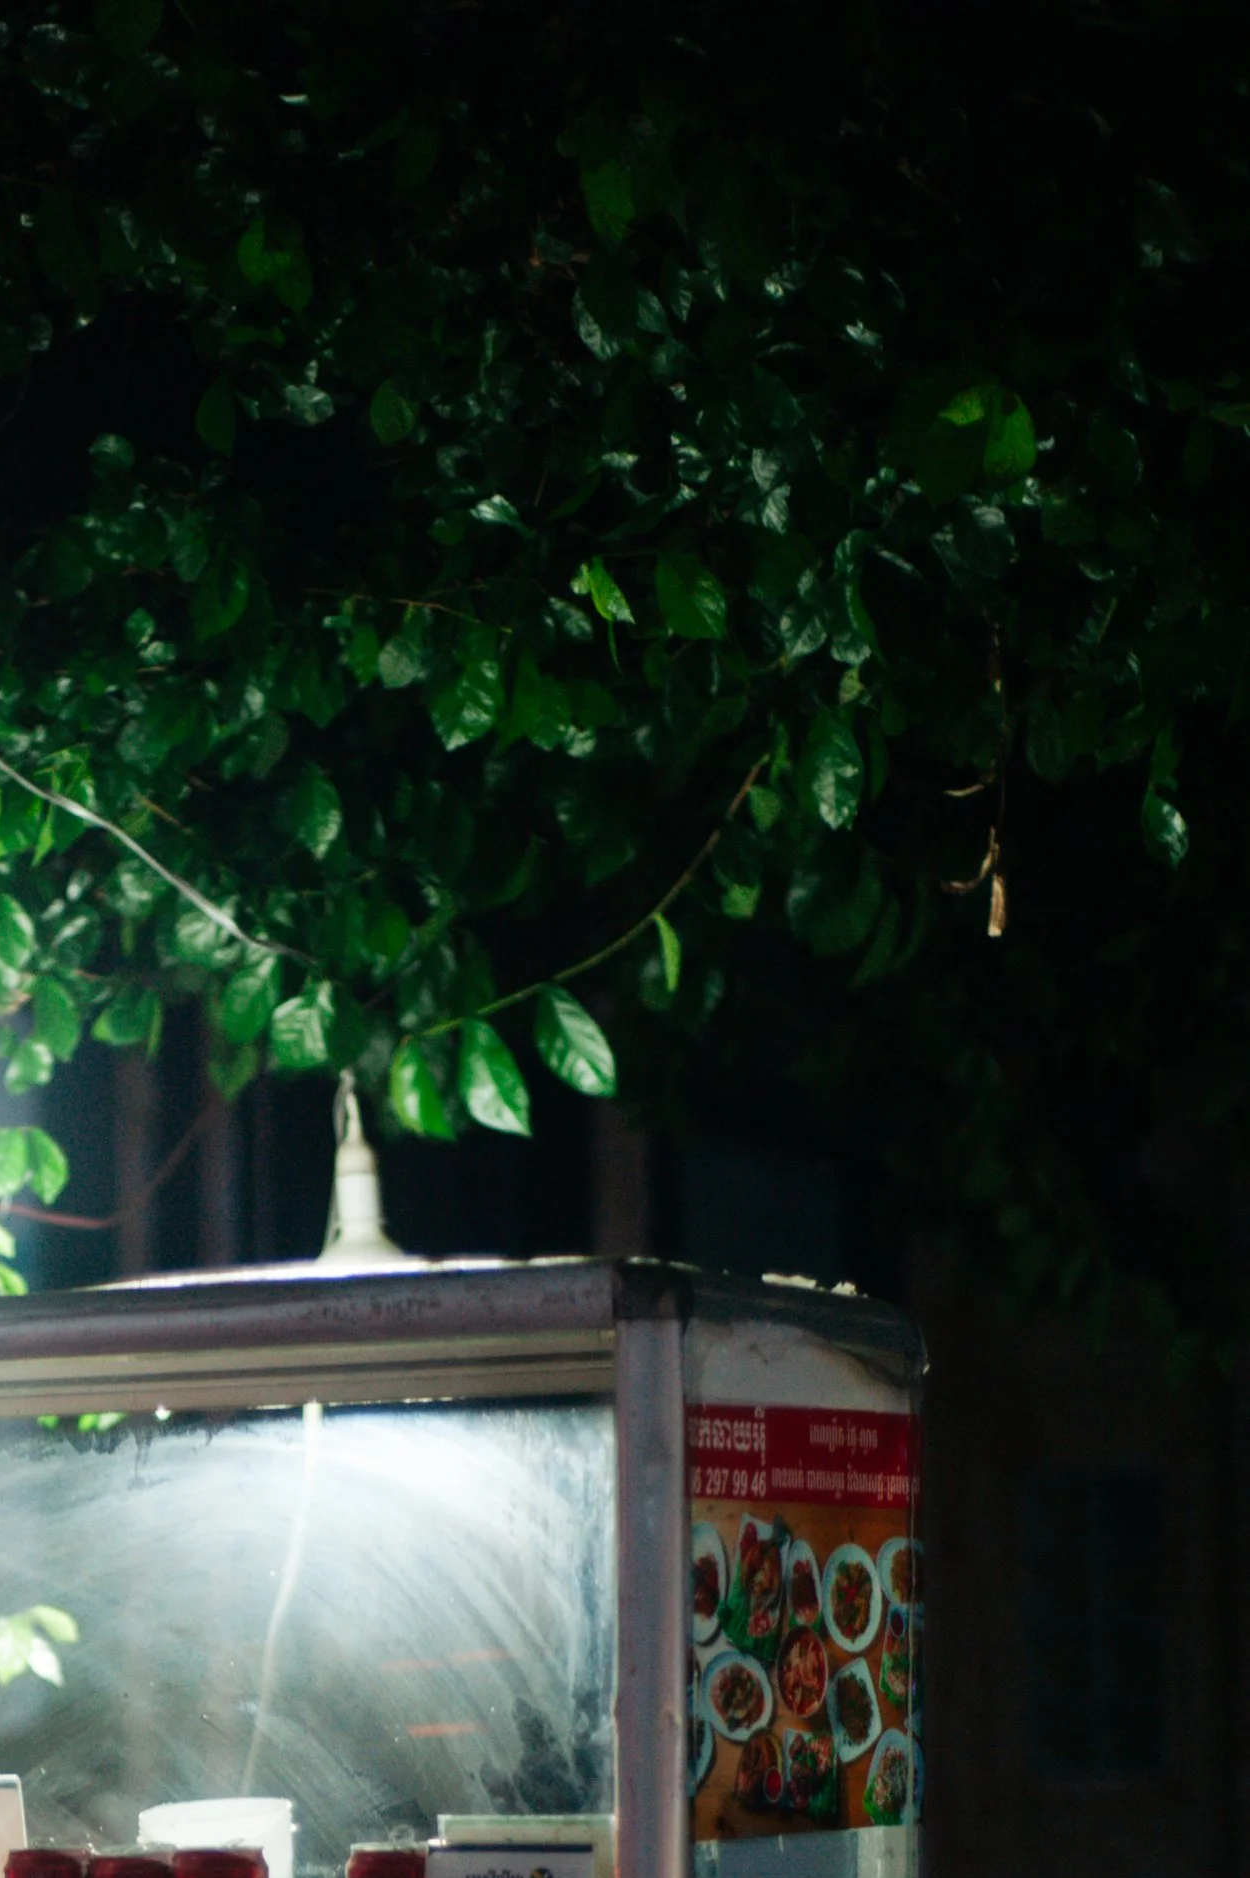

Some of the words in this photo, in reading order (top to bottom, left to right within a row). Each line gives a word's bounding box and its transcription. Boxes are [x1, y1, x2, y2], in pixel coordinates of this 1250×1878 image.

[705, 1467, 729, 1494] 297
[732, 1469, 748, 1496] 99
[751, 1471, 767, 1497] 46
